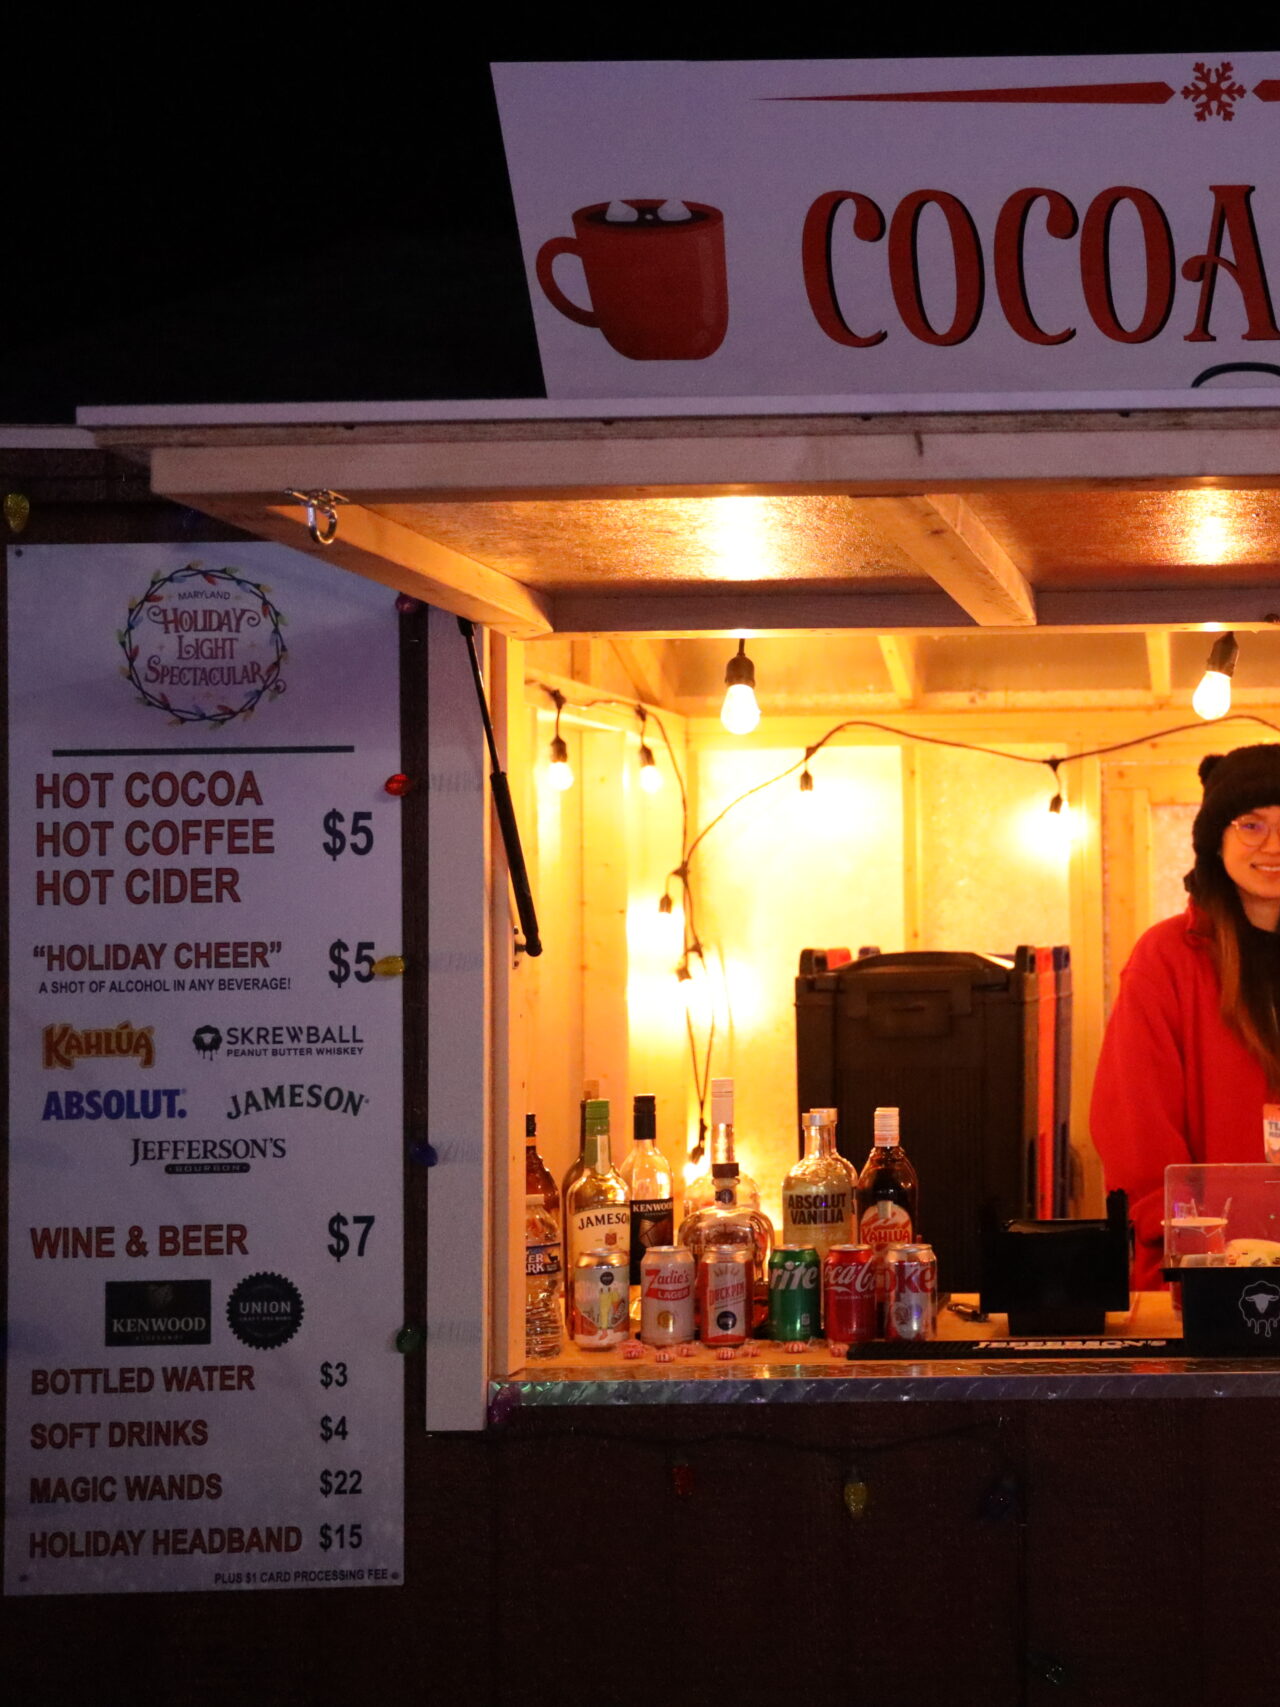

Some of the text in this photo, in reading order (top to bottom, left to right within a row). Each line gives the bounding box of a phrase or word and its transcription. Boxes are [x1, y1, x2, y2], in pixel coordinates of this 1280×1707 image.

[178, 590, 231, 601] MARYLAND
[147, 605, 261, 634] HOLIDAY
[176, 636, 239, 661] LIGHT
[144, 655, 287, 694] SPECTACULAR
[36, 771, 263, 808] HOT COCOA
[36, 819, 274, 857] HOT COFFEE
[322, 809, 374, 861] $5
[36, 868, 241, 905] HOT CIDER
[329, 939, 376, 988] $5
[39, 978, 291, 993] A SHOT OF ALCOHOL IN ANY BEVERAGE!
[227, 1026, 364, 1045] SKREWBALL
[227, 1047, 364, 1057] PEANUT BUTTER WHISKEY
[227, 1084, 364, 1120] JAMESON
[130, 1138, 286, 1166] JEFFERSON'S
[175, 1165, 240, 1173] BOURBON
[788, 1192, 846, 1209] ABSOLUT
[790, 1211, 844, 1225] VANILIA
[31, 1224, 249, 1259] WINE & BEER
[327, 1213, 375, 1262] $7
[657, 1286, 689, 1299] LAGER
[240, 1301, 291, 1314] UNION
[112, 1317, 206, 1332] KENWOOD
[31, 1365, 255, 1395] BOTTLED WATER
[320, 1361, 348, 1389] $3
[31, 1420, 208, 1449] SOFT DRINKS
[320, 1415, 348, 1443] $4
[31, 1473, 222, 1503] MAGIC WANDS
[319, 1470, 362, 1497] $22
[30, 1527, 302, 1558] HOLIDAY HEADBAND
[319, 1523, 362, 1552] $15
[214, 1569, 388, 1584] PLUS $1 CARD PROCESSING FEE
